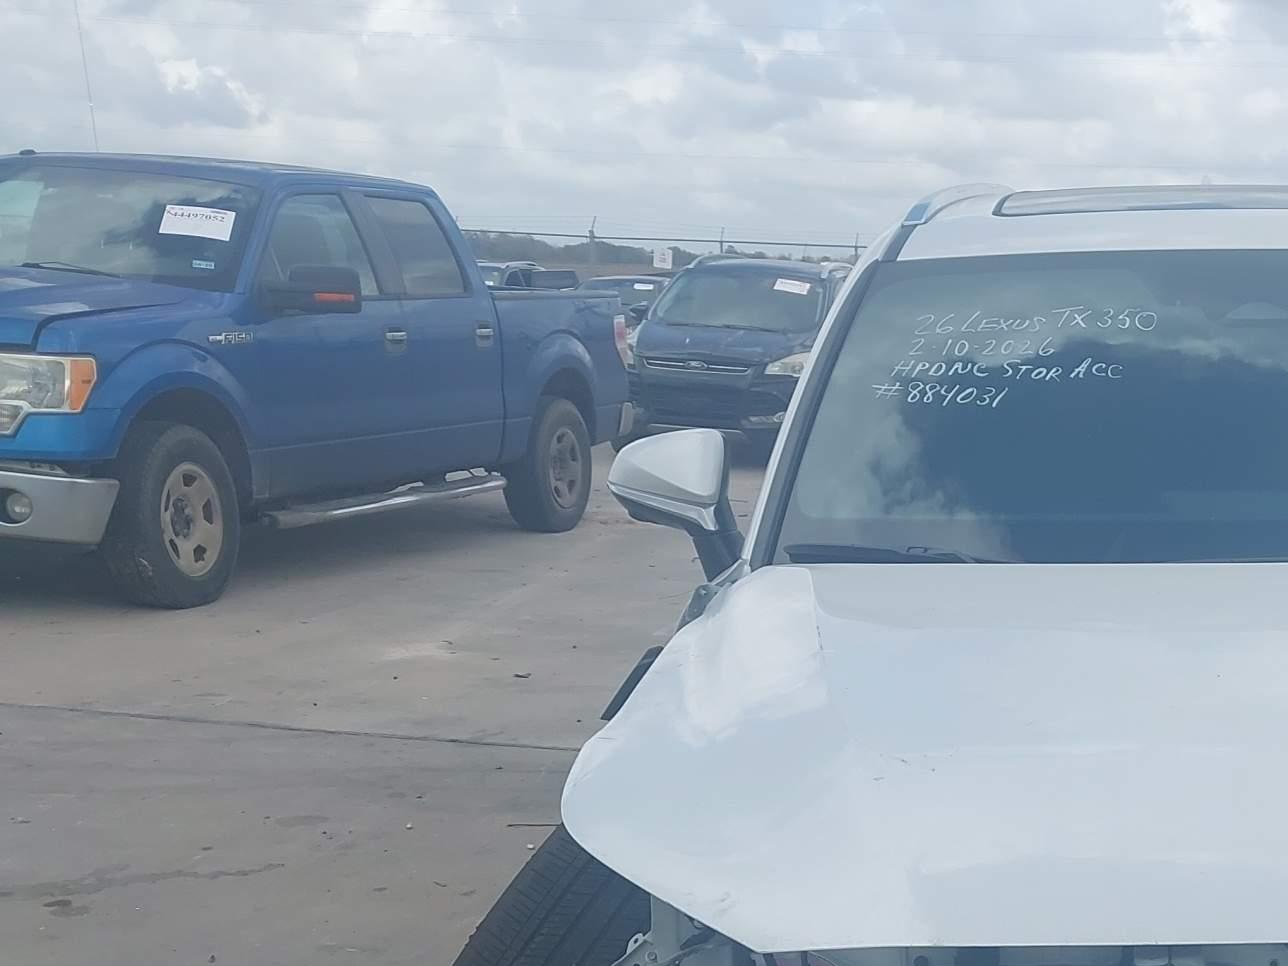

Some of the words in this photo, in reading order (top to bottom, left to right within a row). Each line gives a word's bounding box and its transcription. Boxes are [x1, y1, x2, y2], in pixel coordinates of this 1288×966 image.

[913, 313, 954, 335] 26
[960, 310, 1046, 333] LEXUS
[1050, 305, 1093, 329] TX
[1096, 308, 1159, 331] 350
[908, 337, 1056, 357] 2-10-2026
[1068, 357, 1124, 380] ACC
